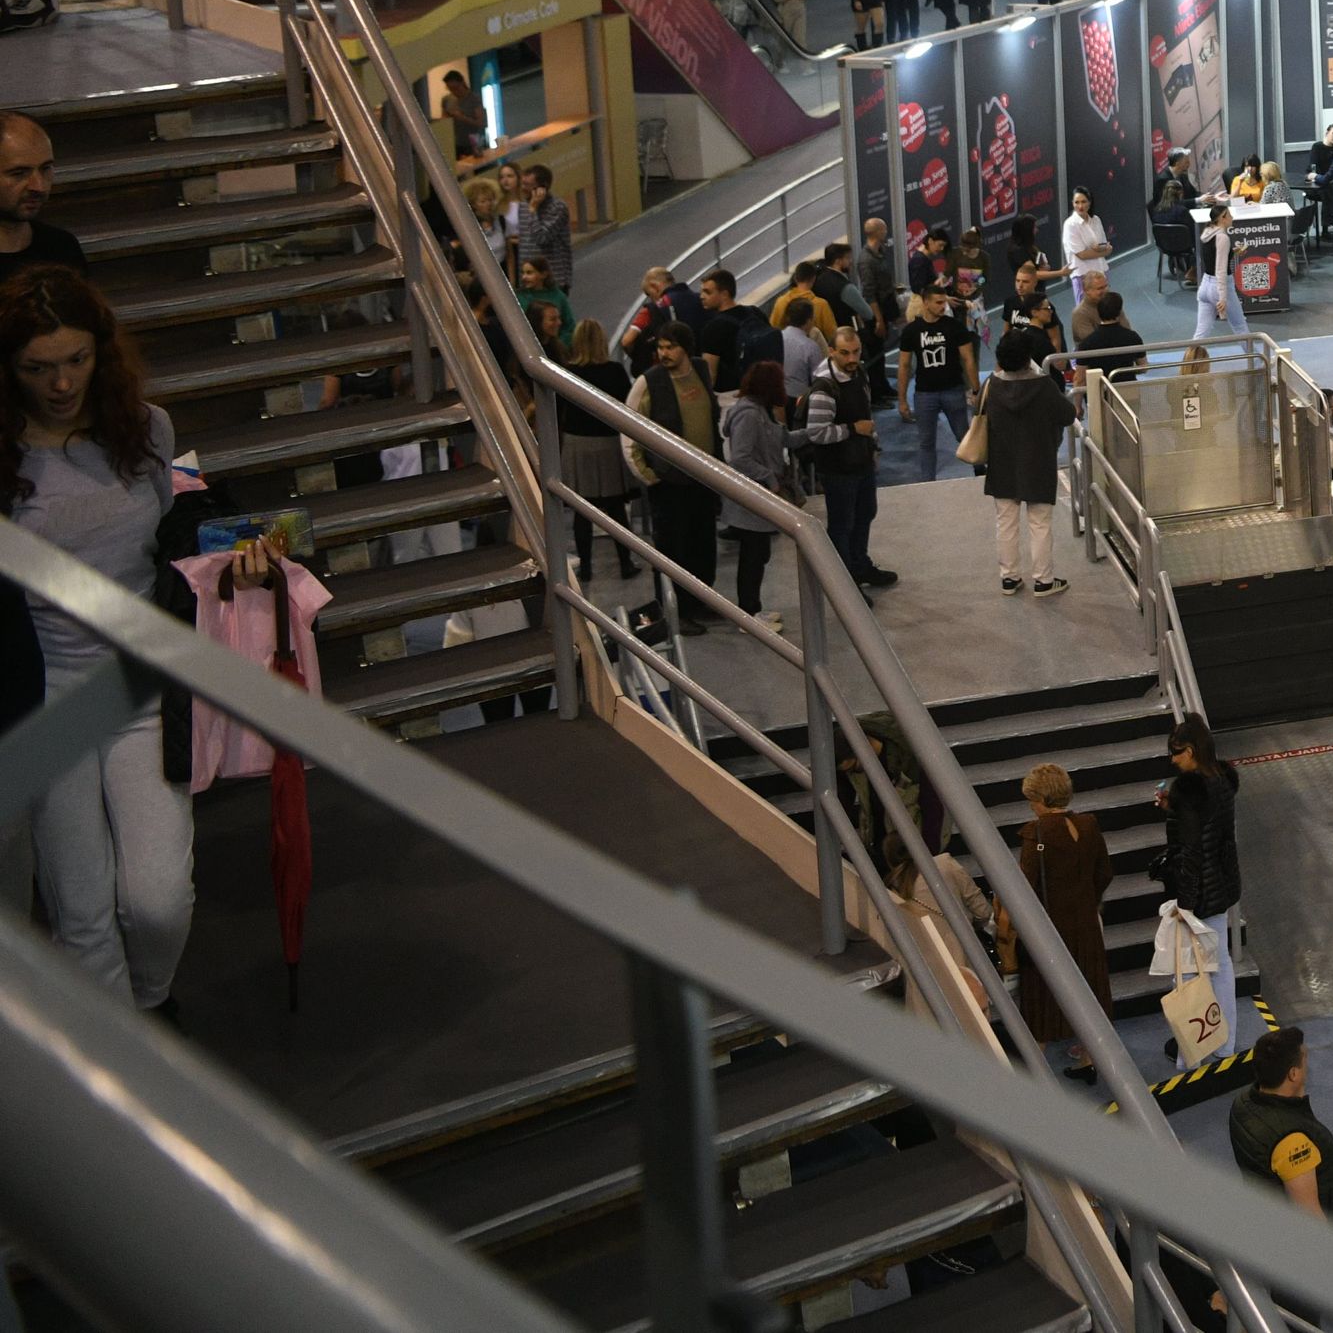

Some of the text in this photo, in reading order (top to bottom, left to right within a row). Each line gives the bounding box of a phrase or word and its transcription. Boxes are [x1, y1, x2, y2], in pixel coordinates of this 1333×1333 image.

[650, 7, 703, 85] vision.
[1227, 223, 1280, 235] Geopoetika
[1235, 237, 1281, 247] e-knjižara
